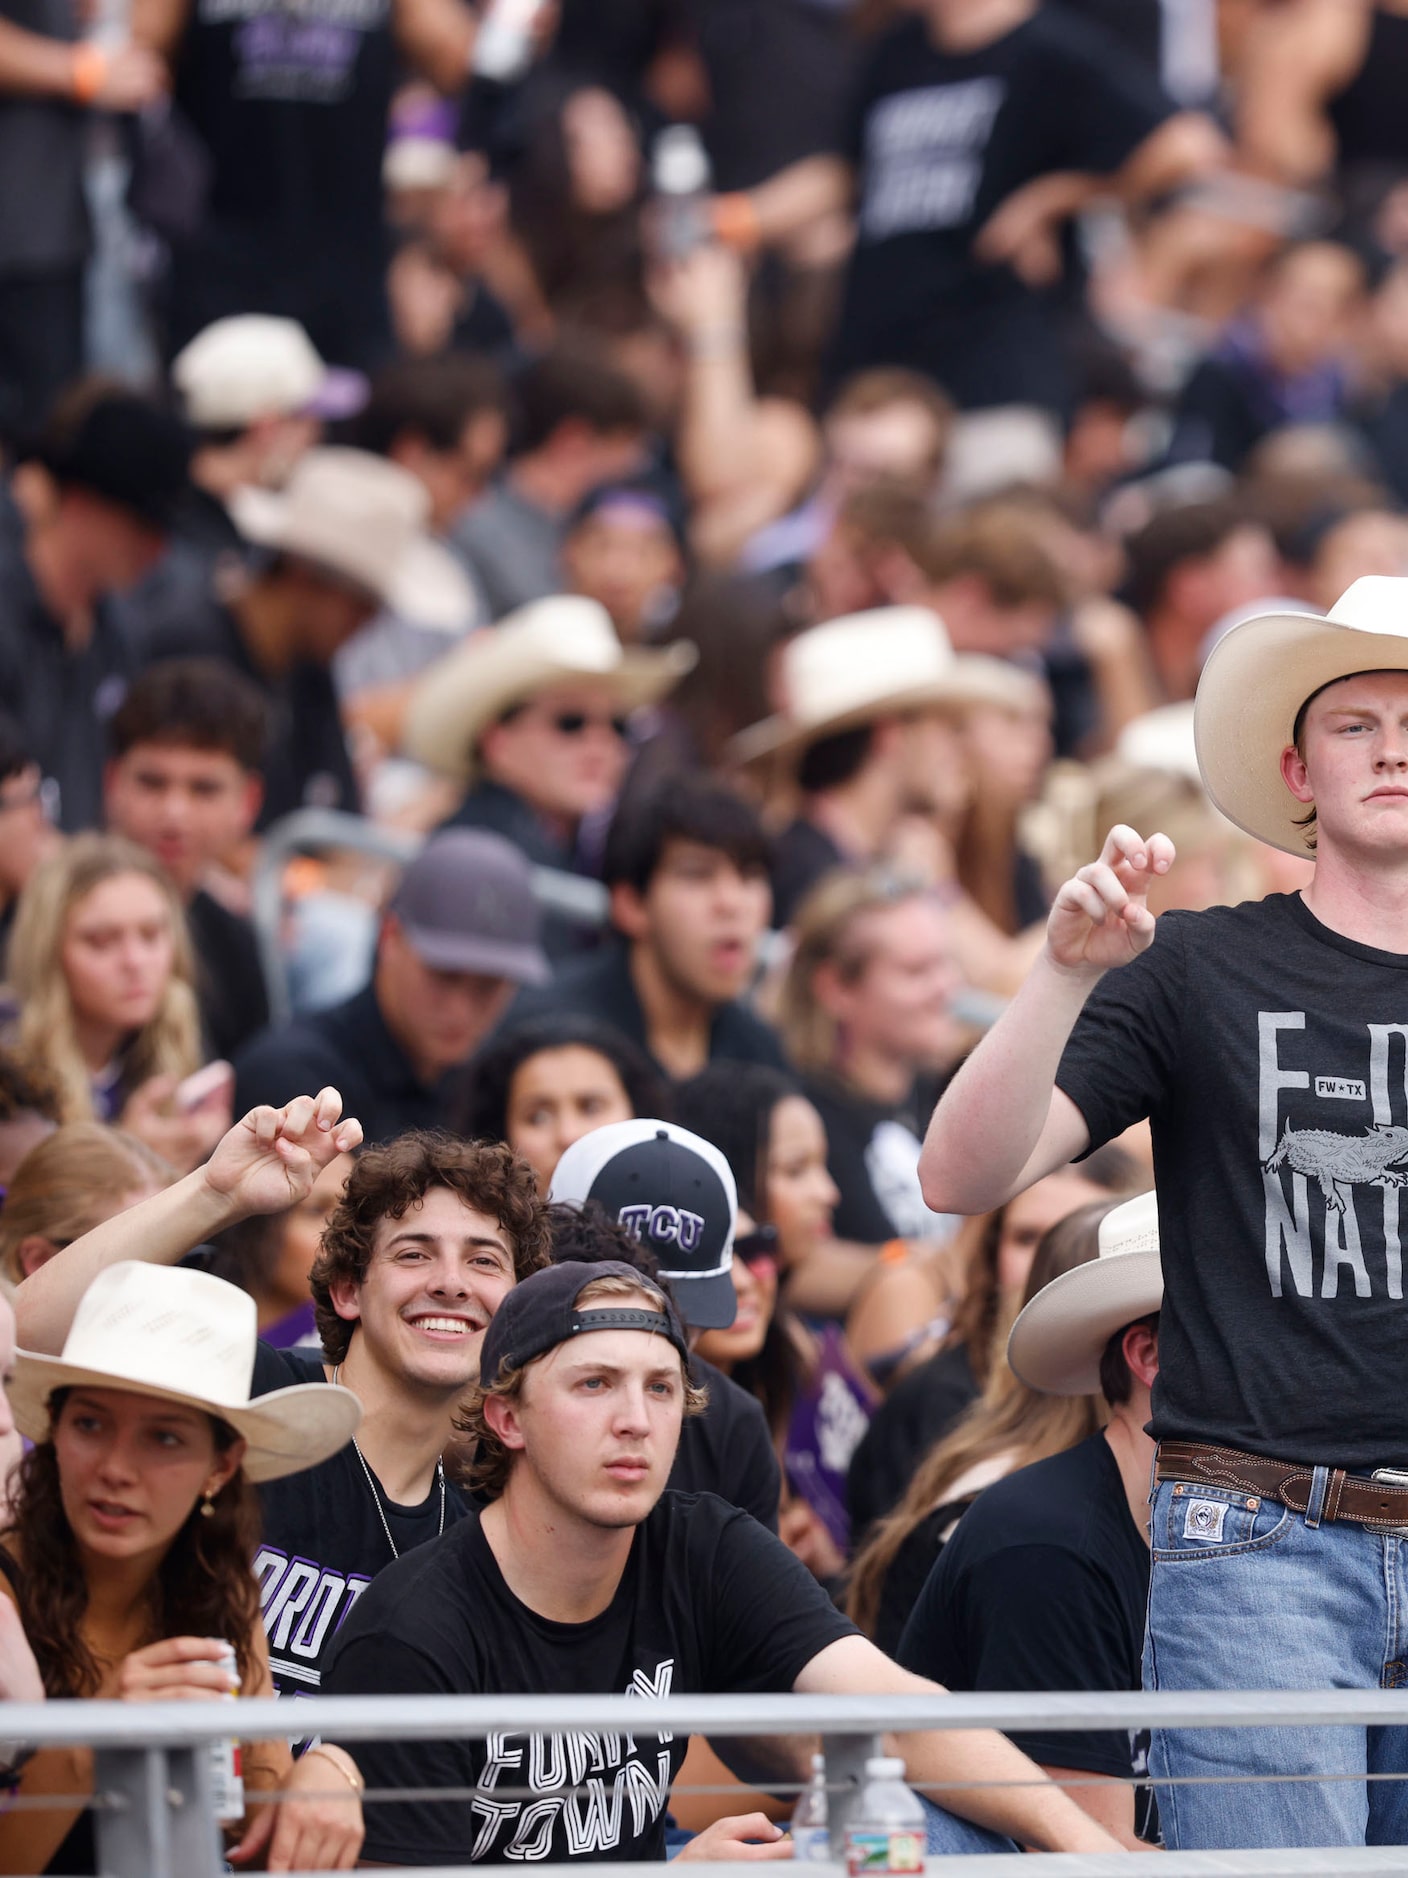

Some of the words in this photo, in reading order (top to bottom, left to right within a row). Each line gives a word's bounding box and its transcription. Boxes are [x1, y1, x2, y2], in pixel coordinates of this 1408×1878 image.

[1318, 1081, 1336, 1093] FW
[1346, 1084, 1362, 1096] TX
[618, 1204, 705, 1254] TCU
[471, 1750, 671, 1861] TOWN
